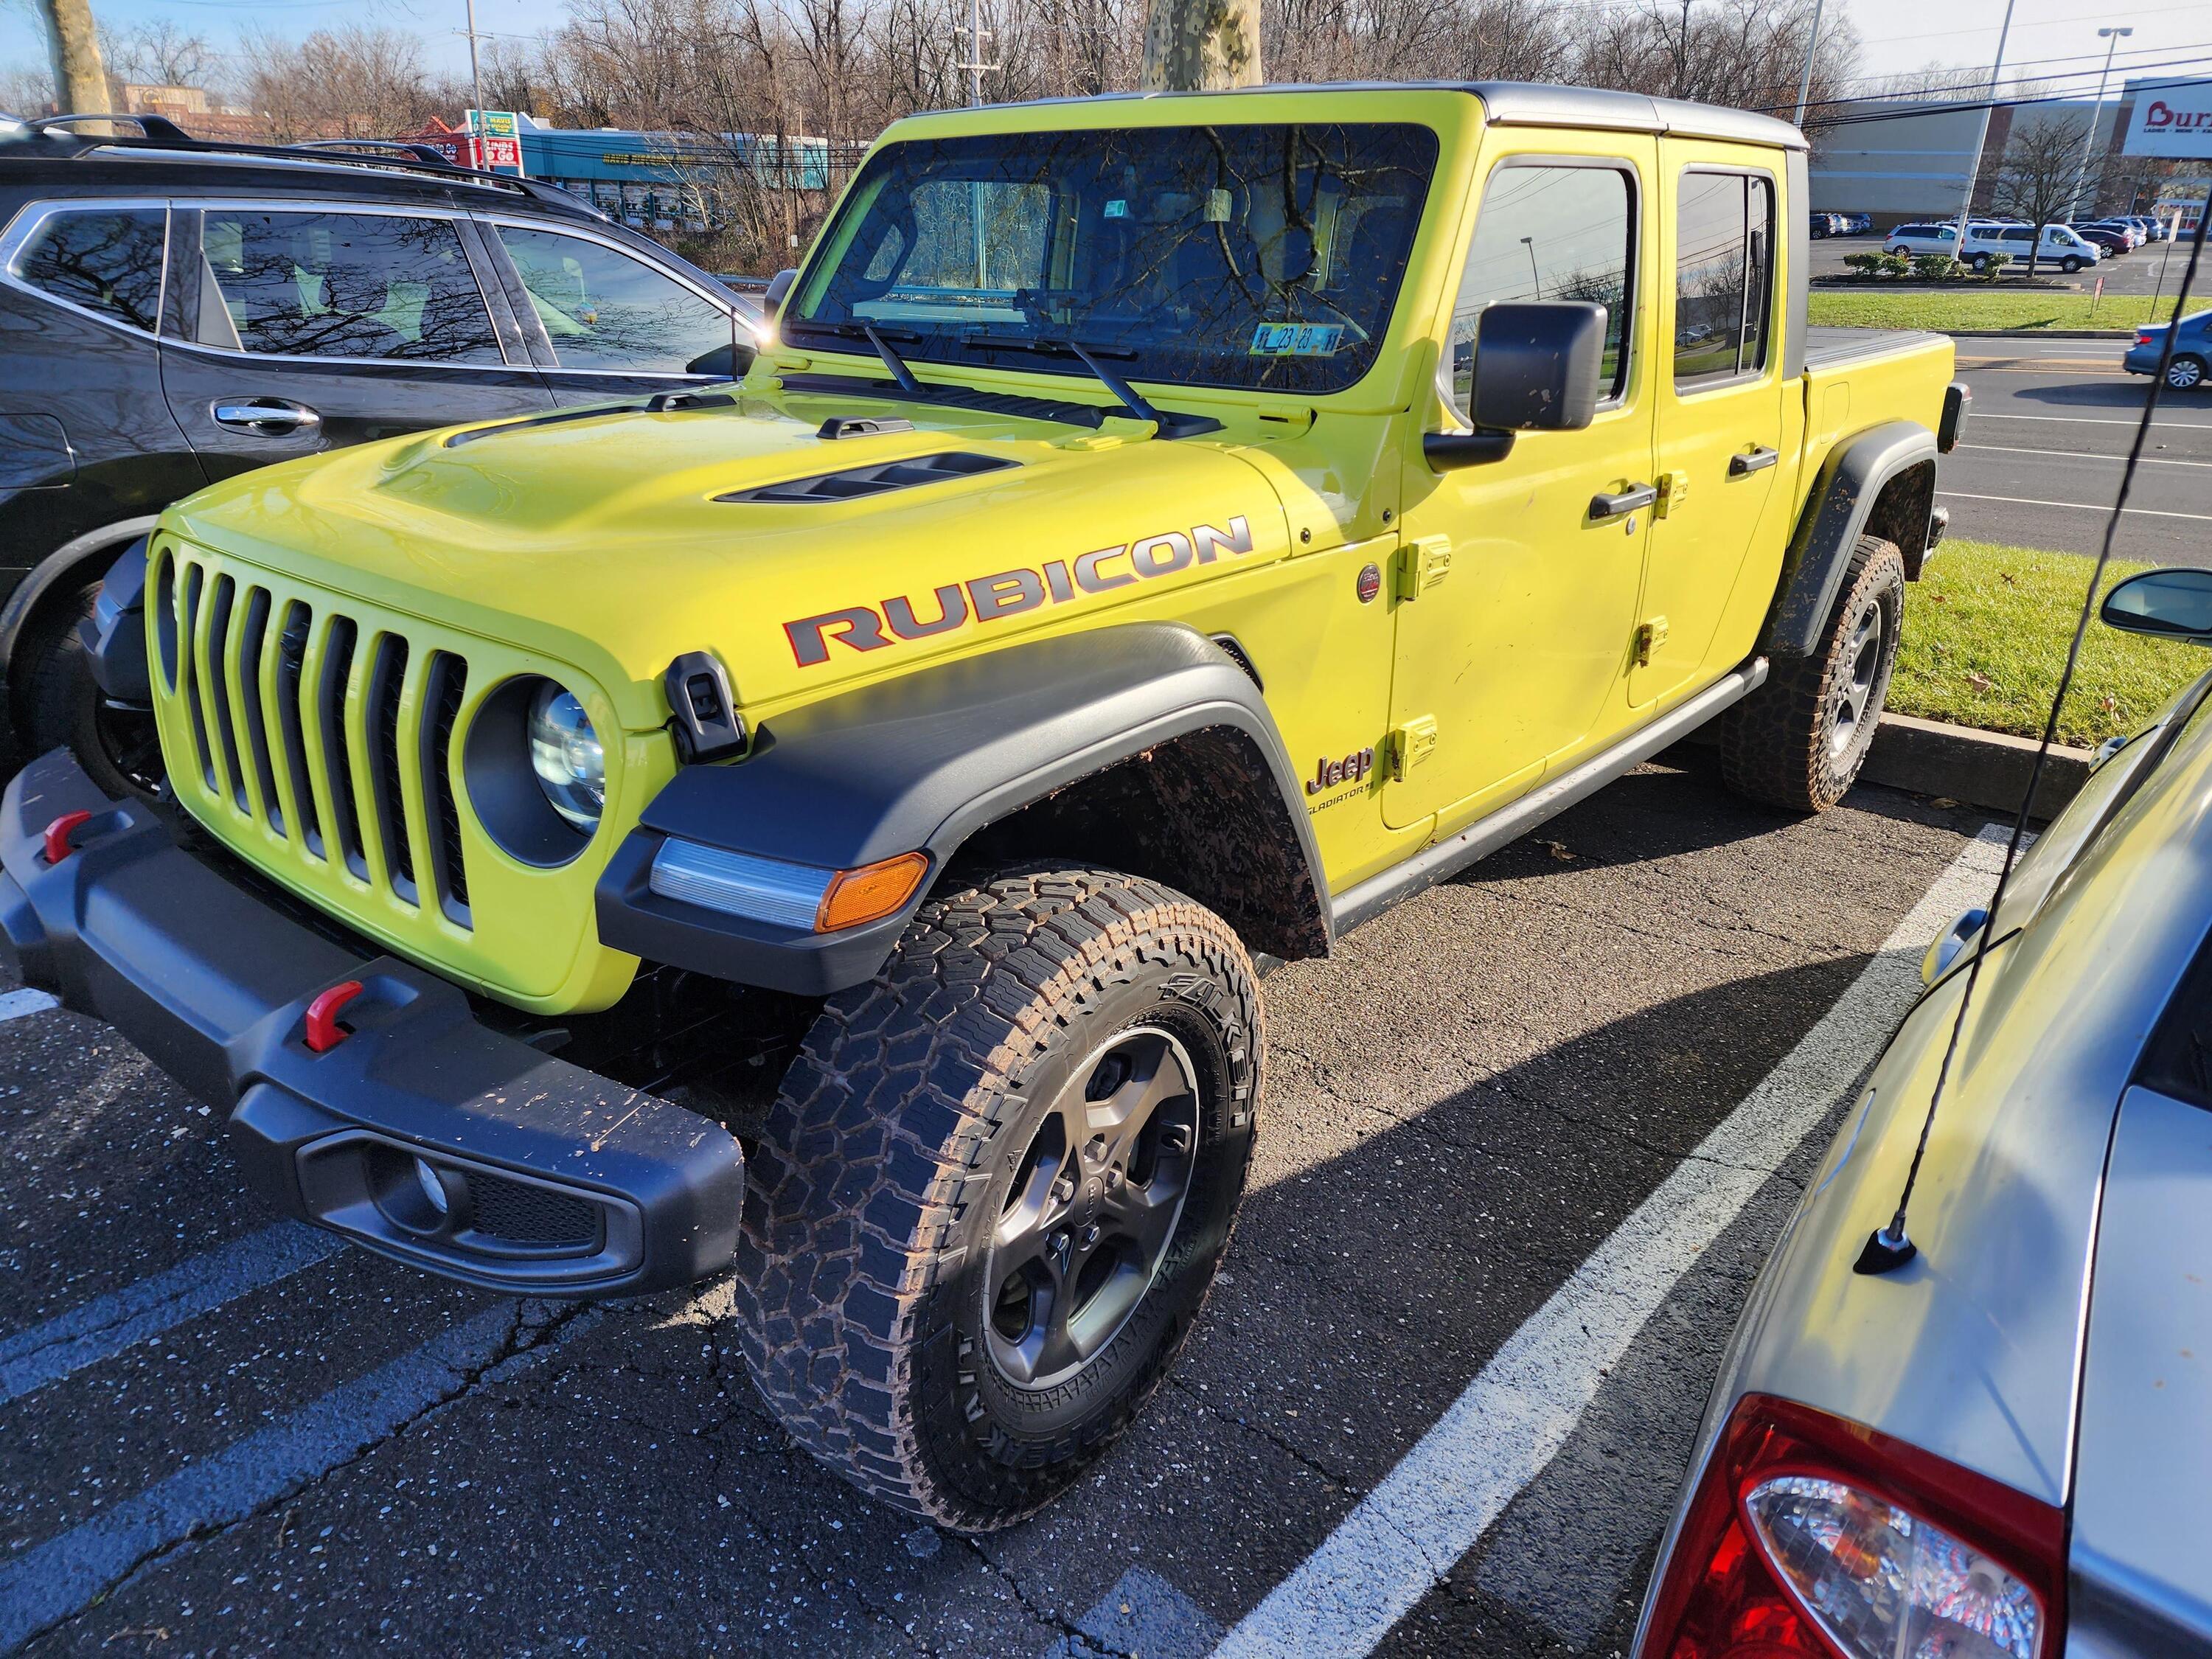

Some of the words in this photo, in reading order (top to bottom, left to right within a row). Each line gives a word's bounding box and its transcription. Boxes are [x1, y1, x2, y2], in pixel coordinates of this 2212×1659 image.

[2146, 101, 2212, 128] Bur
[481, 140, 514, 152] LINDS
[497, 150, 514, 161] GO
[1279, 327, 1294, 349] 23
[782, 515, 1253, 669] RUBICON
[1305, 747, 1374, 796] Jeep
